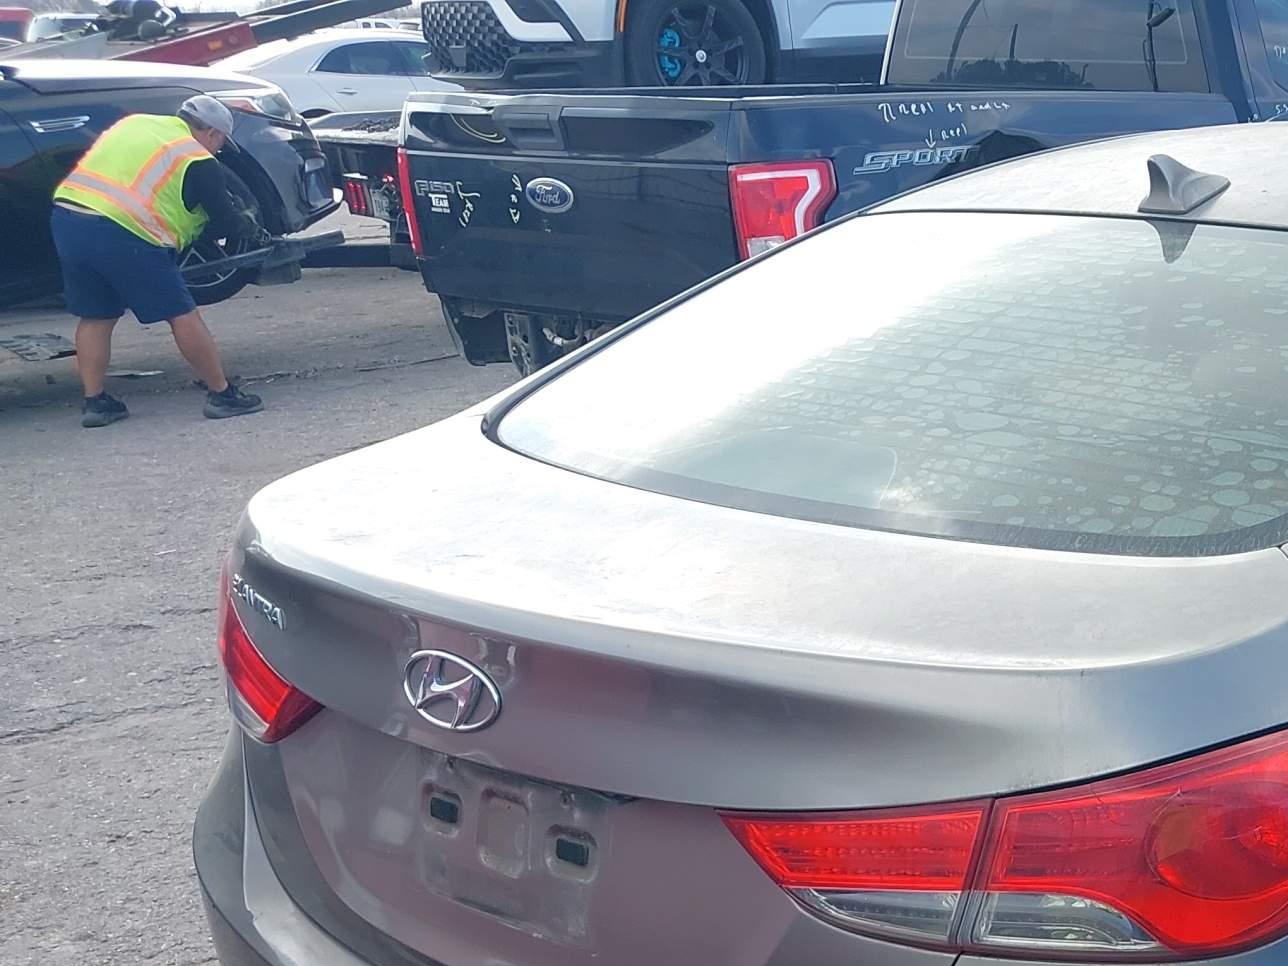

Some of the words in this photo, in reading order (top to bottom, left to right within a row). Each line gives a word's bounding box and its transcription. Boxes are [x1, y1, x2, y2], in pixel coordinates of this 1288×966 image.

[853, 145, 977, 175] SPORT
[536, 184, 561, 205] Ford
[233, 573, 286, 631] ELANTRA
